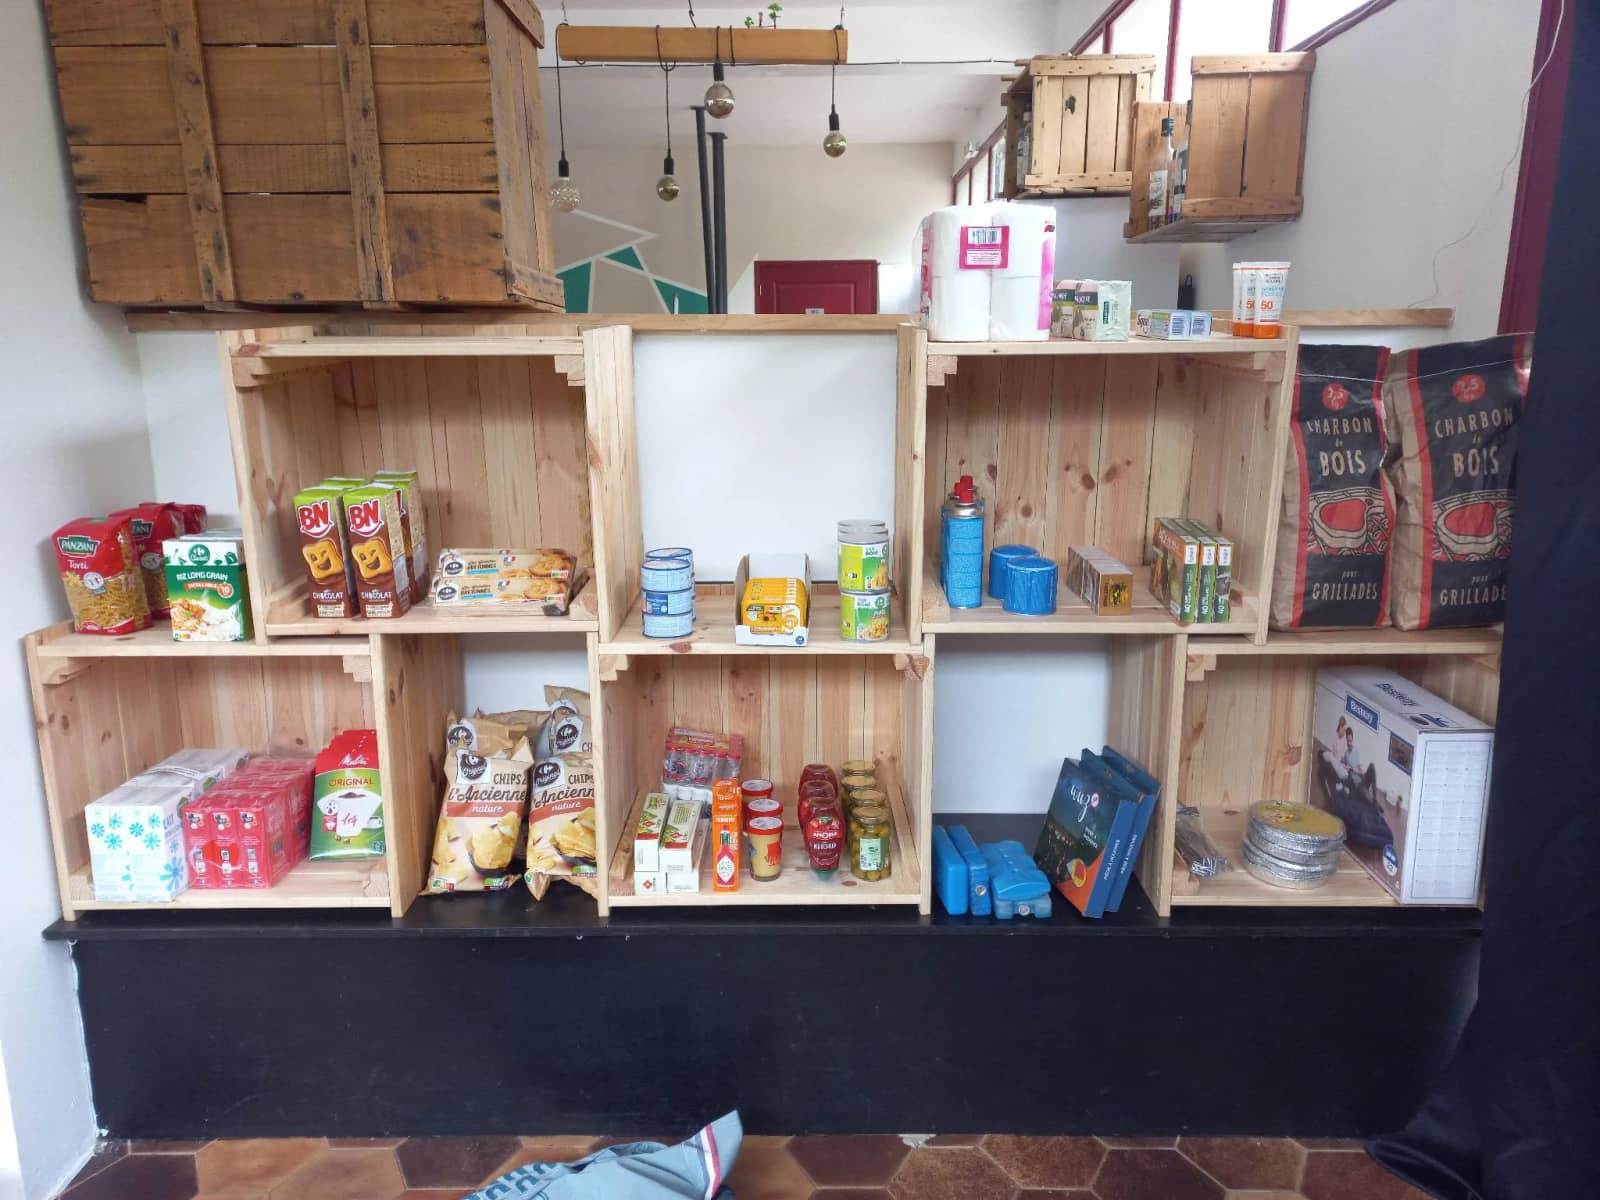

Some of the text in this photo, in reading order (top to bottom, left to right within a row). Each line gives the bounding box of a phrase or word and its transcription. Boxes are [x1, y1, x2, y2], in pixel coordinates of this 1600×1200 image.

[1306, 417, 1372, 435] CHARBON
[1434, 407, 1513, 438] CHARBON
[1320, 450, 1366, 476] BOIS
[1453, 446, 1499, 477] BOIS
[299, 501, 329, 530] BN
[350, 500, 379, 529] BN
[61, 540, 95, 551] PANZANI
[67, 559, 89, 570] Torti
[312, 591, 344, 599] CHOCOLAT
[361, 591, 392, 599] CHOCOLAT
[1312, 582, 1377, 601] GRILLADES
[1440, 584, 1507, 606] GRILLADE
[329, 777, 374, 787] ORIGINAL
[494, 773, 522, 785] CHIPS
[472, 805, 503, 813] nature
[551, 802, 581, 812] nature
